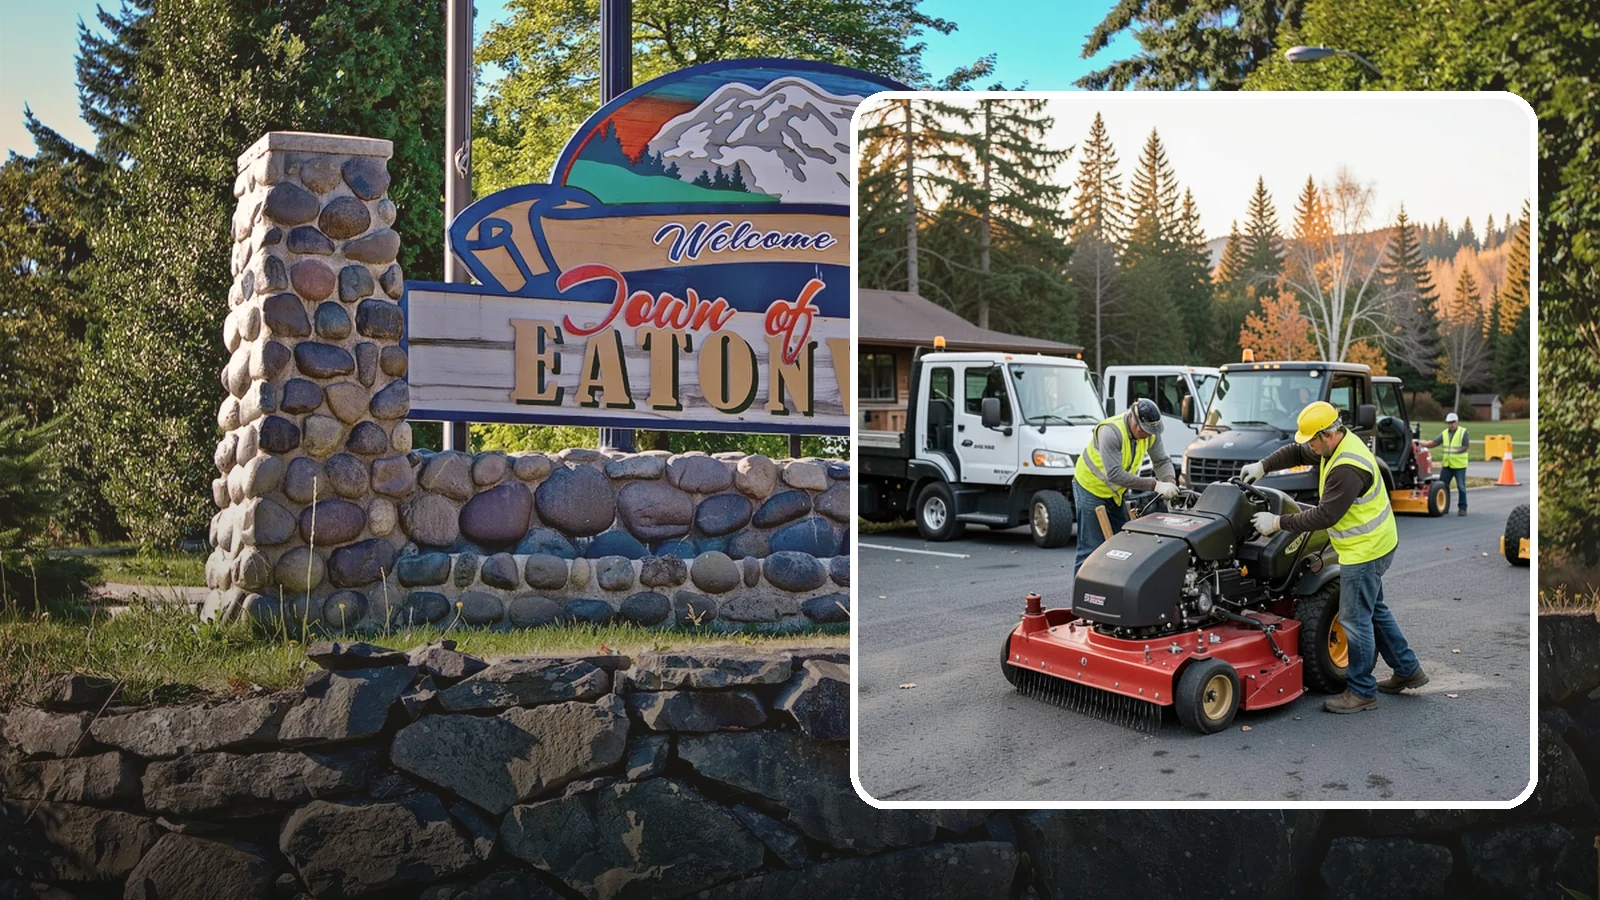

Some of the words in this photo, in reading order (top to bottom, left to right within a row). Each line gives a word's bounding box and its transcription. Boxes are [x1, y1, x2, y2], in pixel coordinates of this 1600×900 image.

[653, 221, 836, 262] Welcome
[557, 264, 736, 336] Town
[765, 278, 825, 364] of
